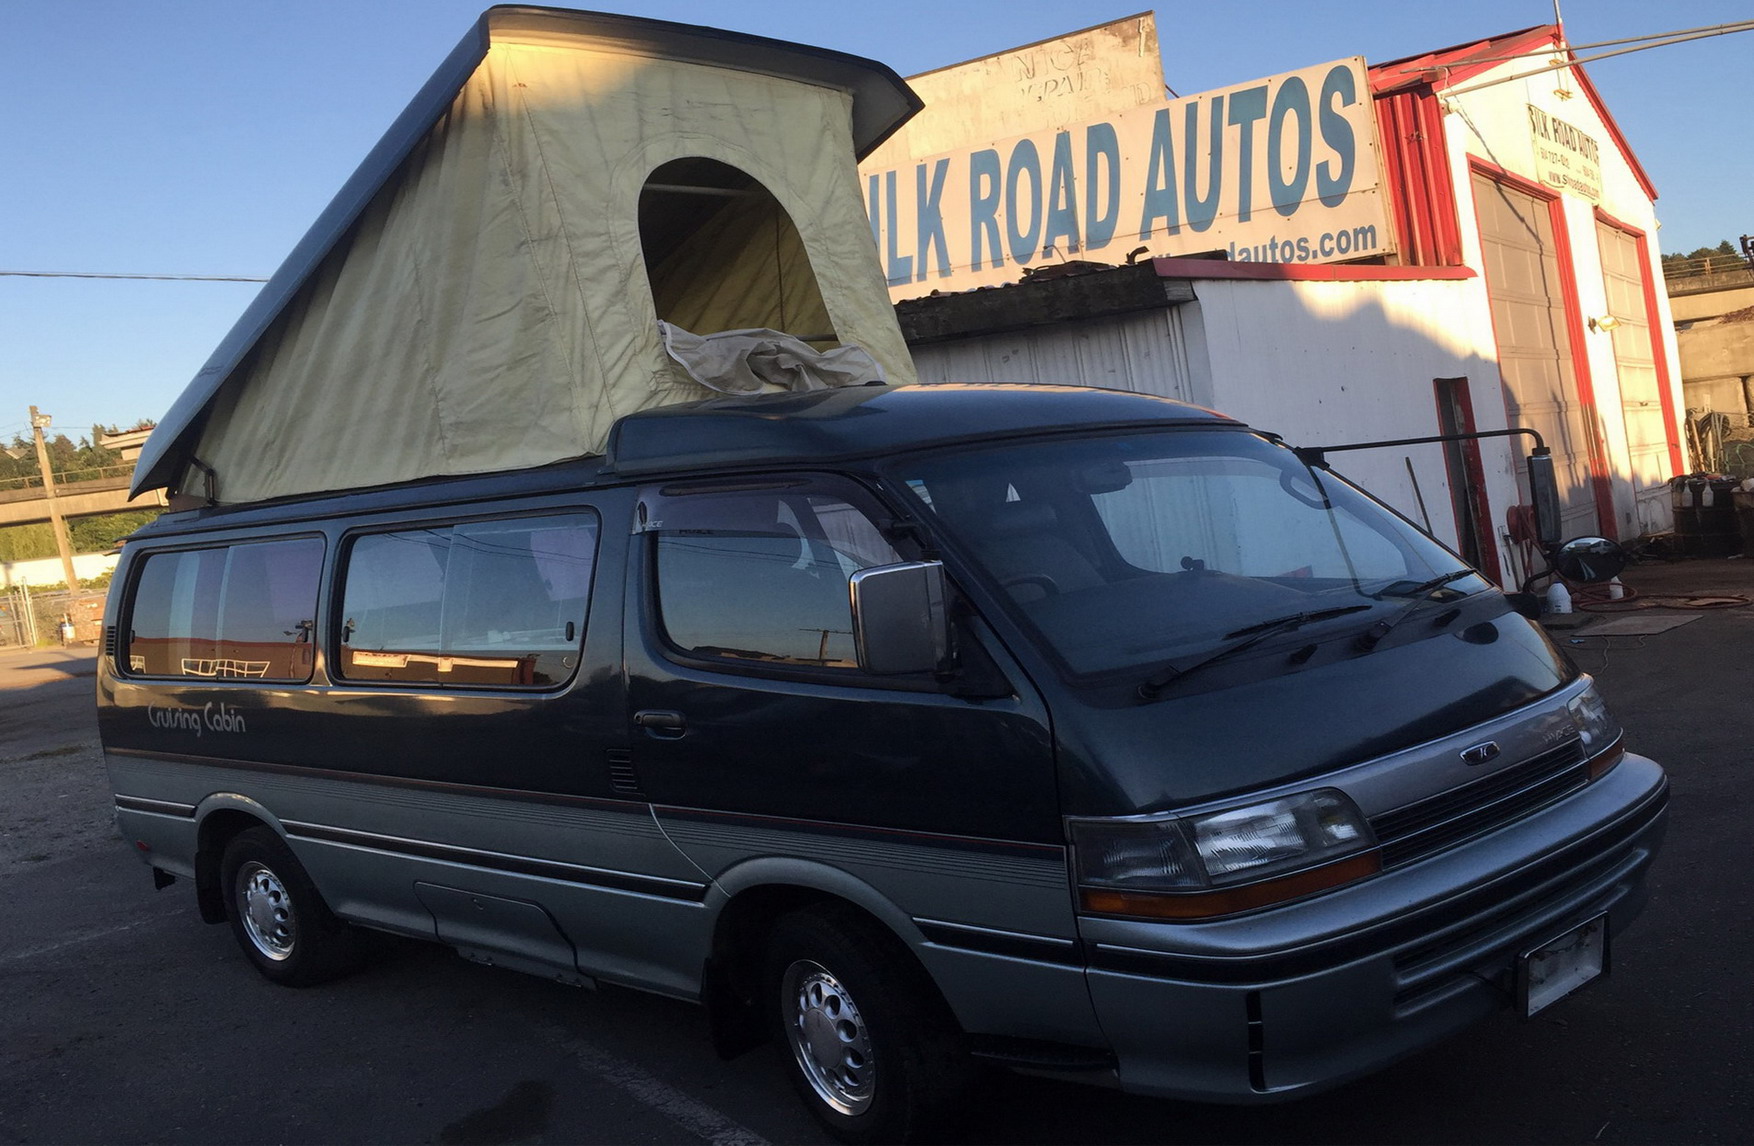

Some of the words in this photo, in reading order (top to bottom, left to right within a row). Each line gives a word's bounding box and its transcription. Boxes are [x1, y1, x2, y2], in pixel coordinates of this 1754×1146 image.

[1527, 104, 1551, 141] SILK
[1551, 116, 1577, 153] ROAD
[970, 122, 1121, 273] ROAD
[1138, 64, 1357, 241] AUTOS
[147, 700, 202, 737] Cruising
[204, 701, 246, 732] Cabin
